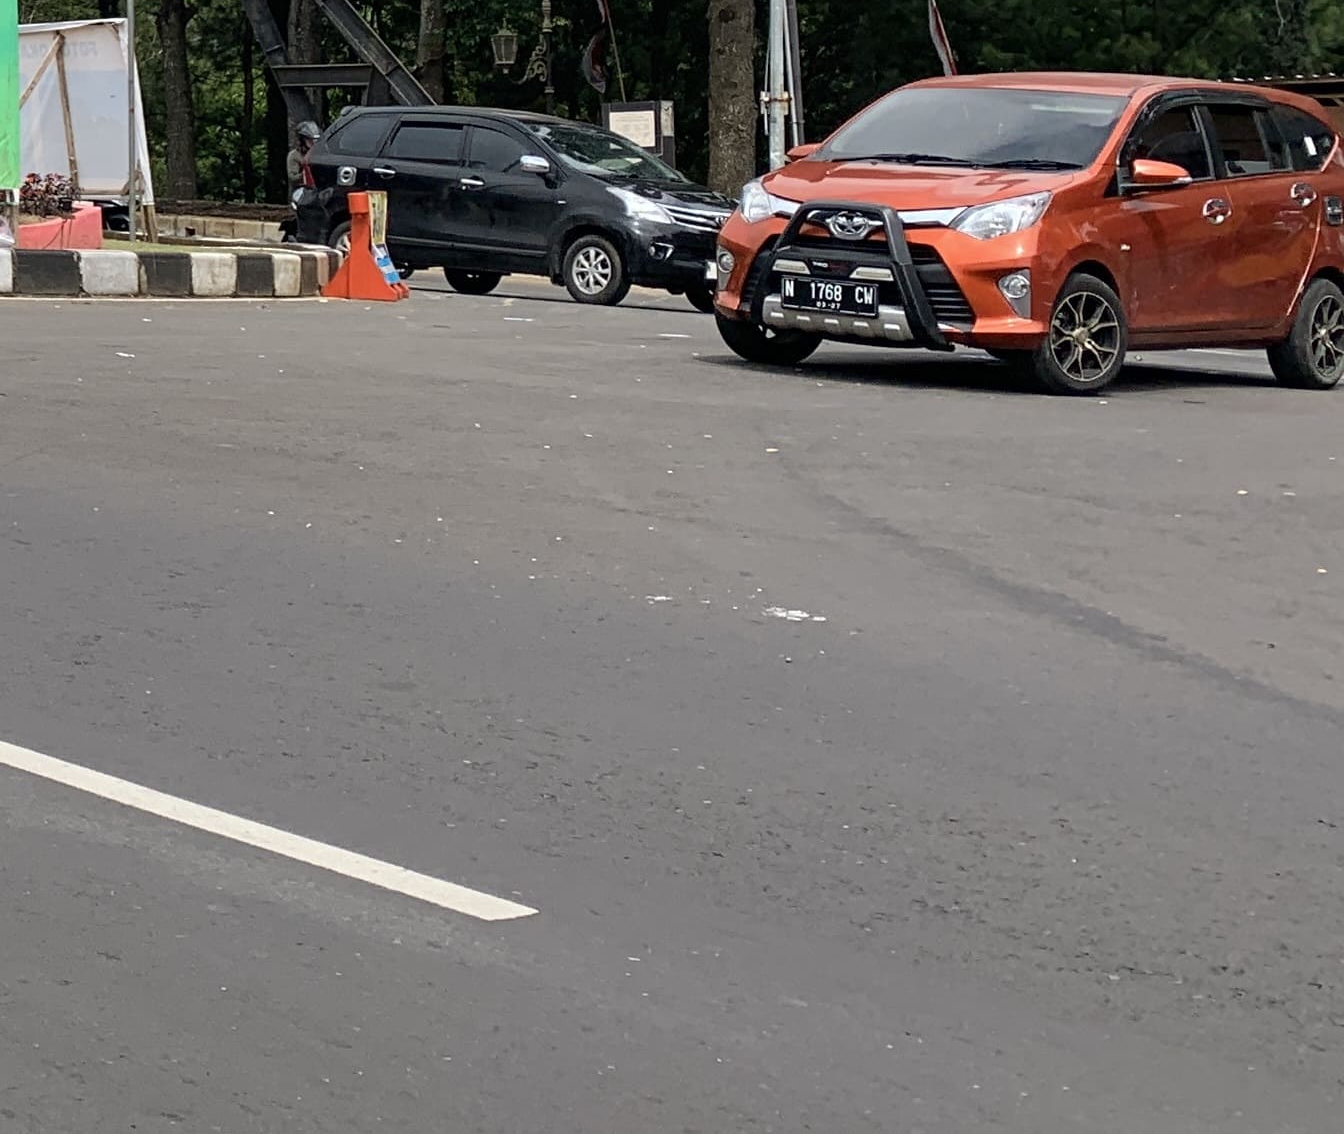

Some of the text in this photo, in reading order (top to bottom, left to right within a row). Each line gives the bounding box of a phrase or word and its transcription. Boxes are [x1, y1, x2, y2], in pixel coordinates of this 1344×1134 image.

[785, 279, 873, 304] N 1768 CW
